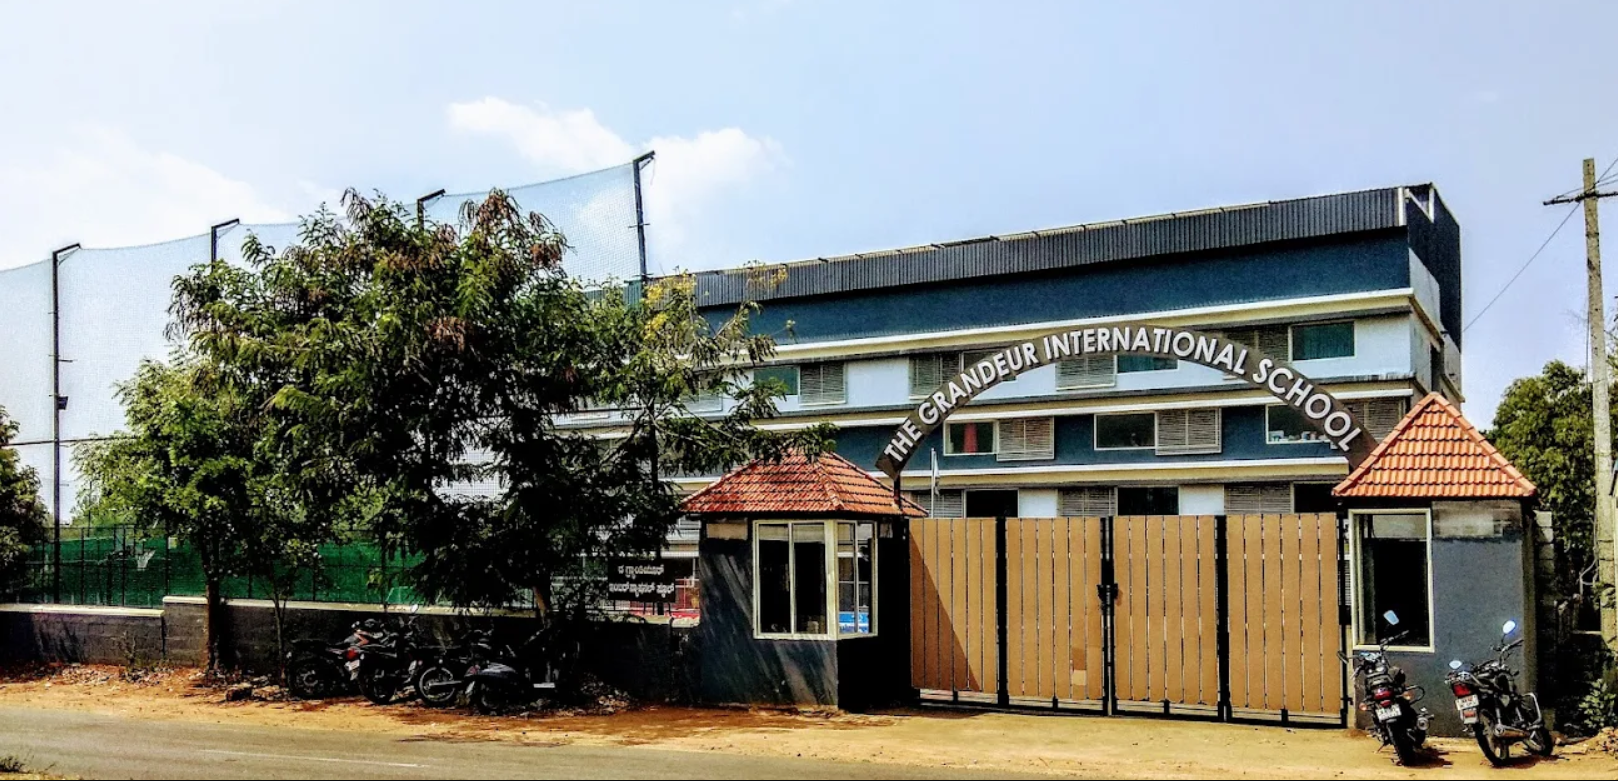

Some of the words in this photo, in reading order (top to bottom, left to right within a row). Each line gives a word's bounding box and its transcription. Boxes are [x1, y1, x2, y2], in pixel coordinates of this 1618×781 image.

[884, 418, 922, 462] THE
[918, 342, 1038, 426] GRANDEUR
[1043, 327, 1248, 374] INTERNATIONAL
[1253, 358, 1362, 452] SCHOOL
